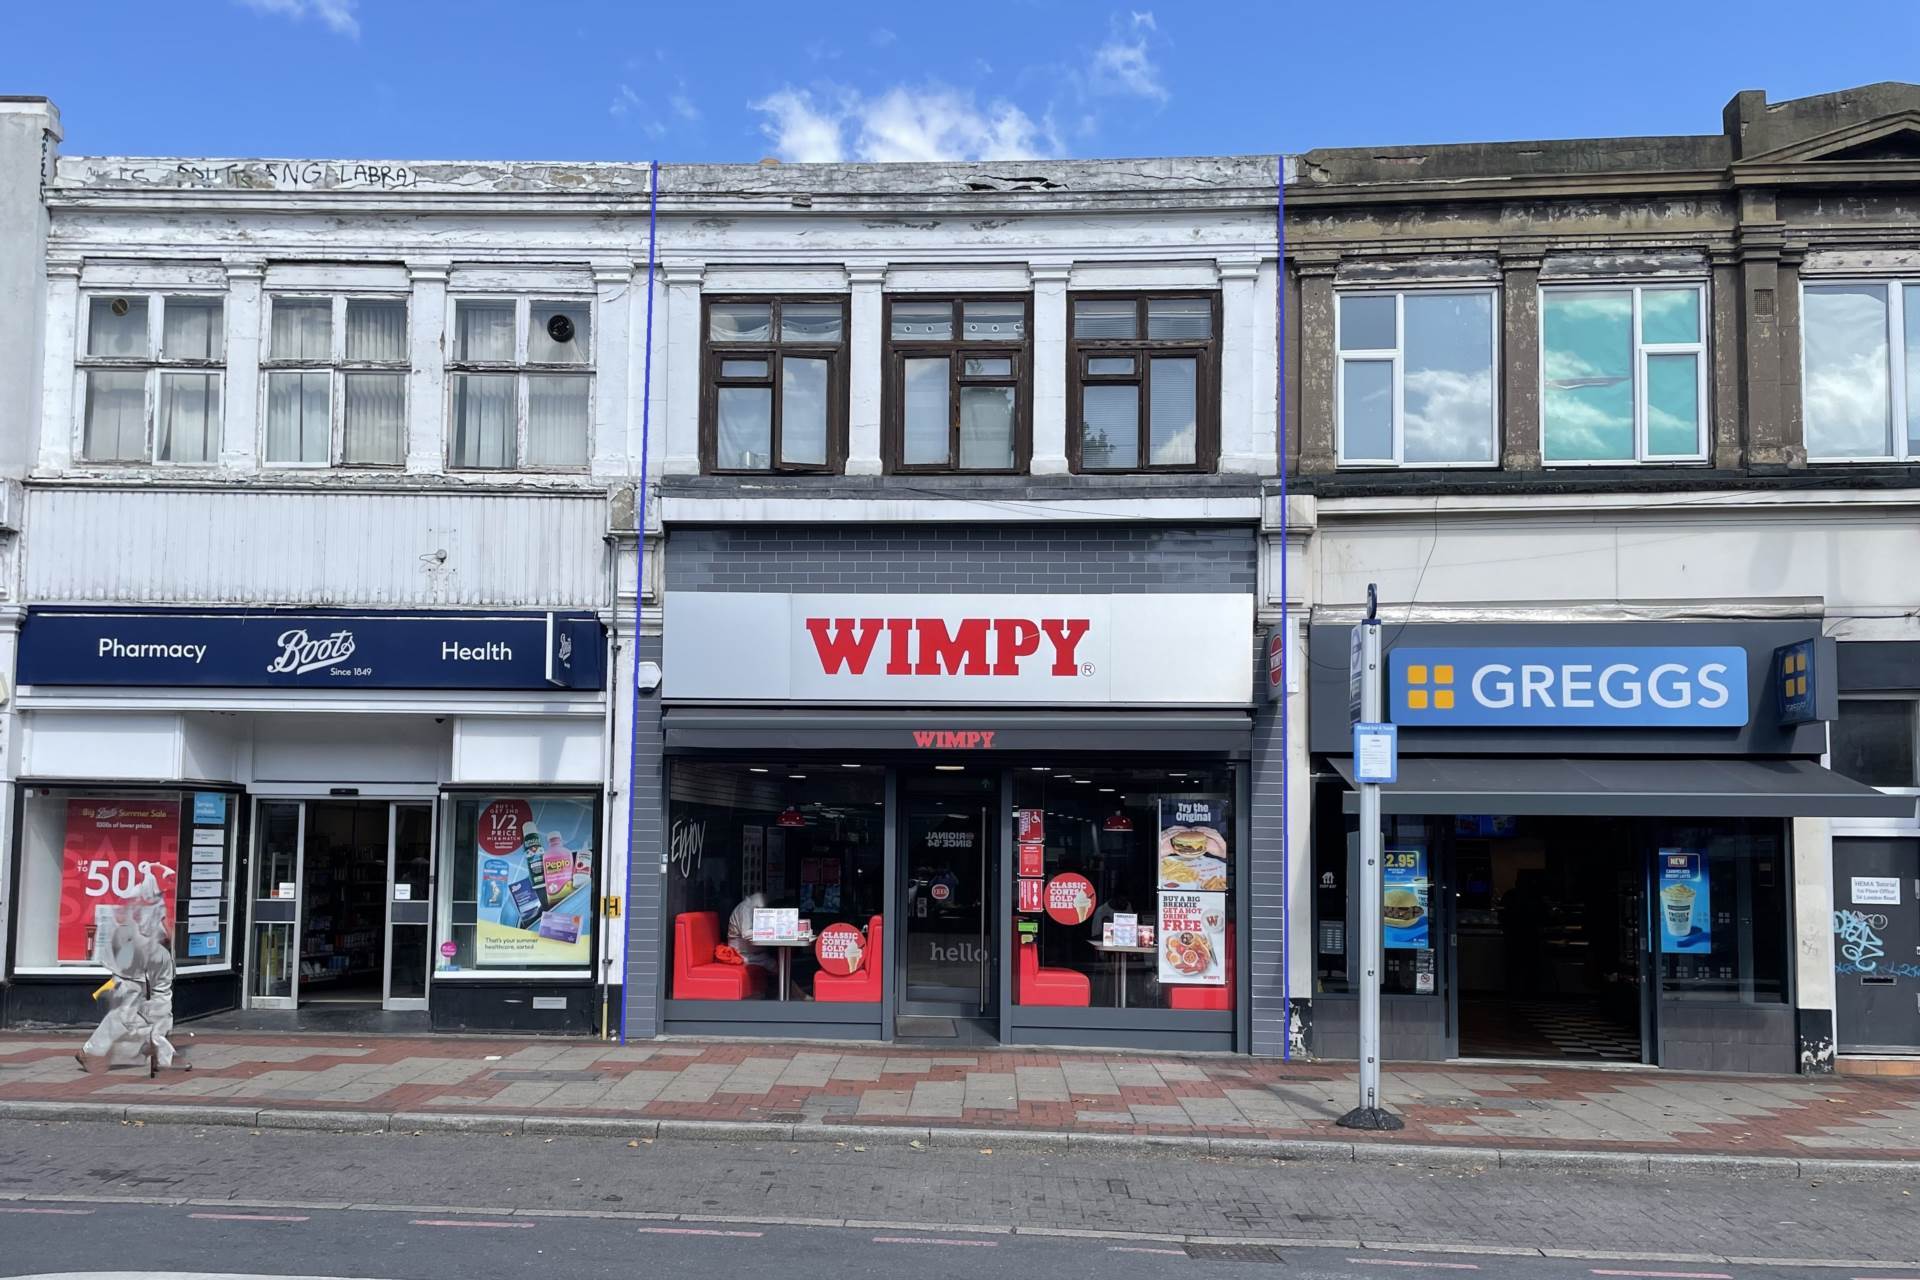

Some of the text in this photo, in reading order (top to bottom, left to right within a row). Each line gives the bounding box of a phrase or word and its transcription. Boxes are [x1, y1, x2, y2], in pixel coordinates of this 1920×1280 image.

[99, 638, 207, 664] Pharmacy
[267, 629, 356, 675] Boots
[442, 641, 513, 661] Health
[806, 618, 1090, 676] WIMPY
[330, 667, 372, 676] Since 1849
[1471, 663, 1729, 709] GREGGS
[913, 731, 995, 749] WIMPY
[119, 809, 149, 817] Summer
[151, 809, 167, 818] Sale
[1178, 803, 1209, 813] Try the
[490, 814, 517, 830] 1/2
[1176, 812, 1211, 823] Original
[670, 818, 706, 879] Enjoy
[545, 860, 570, 870] Pepto
[1384, 853, 1415, 867] 2.95
[1670, 857, 1685, 865] NEW
[1163, 920, 1202, 932] FREE
[1206, 915, 1219, 927] W
[822, 931, 859, 940] CLASSIC
[930, 942, 988, 962] hello
